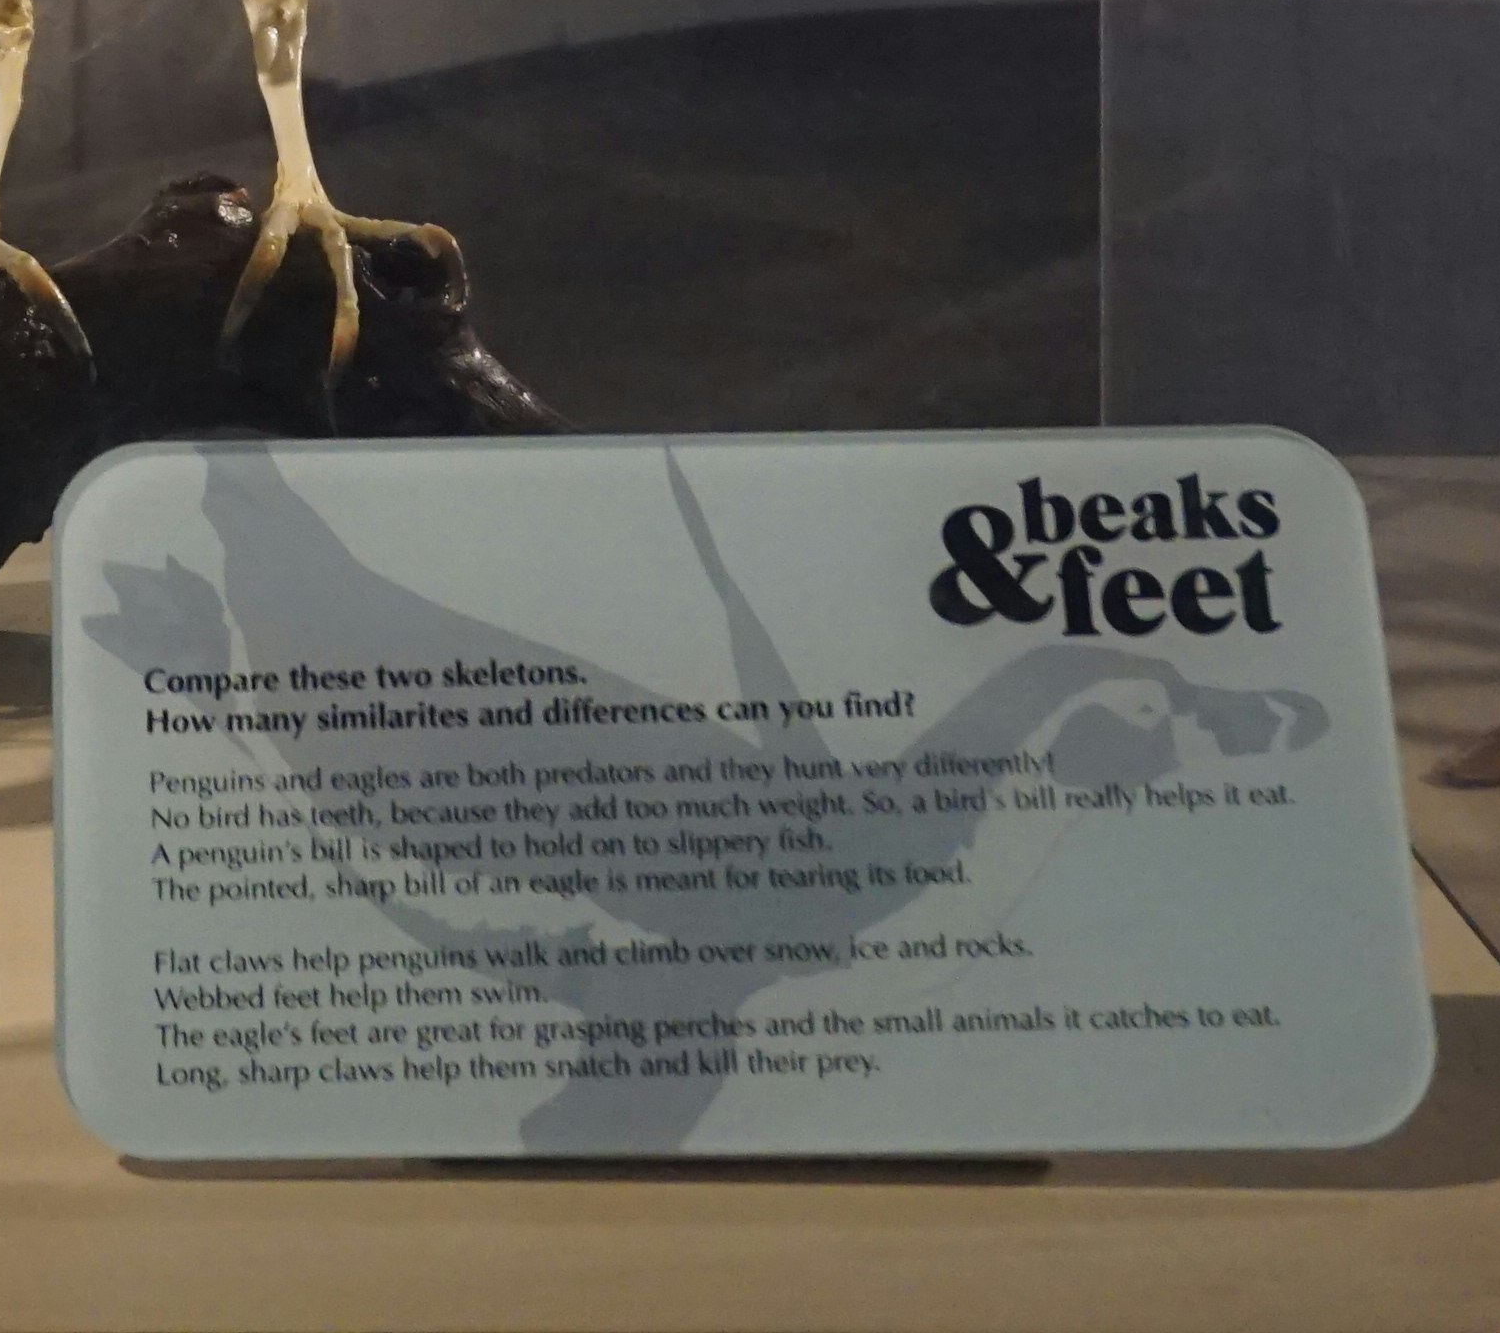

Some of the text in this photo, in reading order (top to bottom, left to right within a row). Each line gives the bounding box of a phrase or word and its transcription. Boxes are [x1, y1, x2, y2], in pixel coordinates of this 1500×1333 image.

[1018, 472, 1281, 545] beaks
[929, 504, 1283, 638] & feet
[144, 660, 587, 702] Compare these two skeletons.
[146, 690, 916, 739] How many similarites and differences can you find?
[150, 768, 265, 798] Penguins
[275, 766, 322, 792] and
[331, 766, 411, 796] eagles
[420, 767, 459, 788] are
[468, 761, 525, 787] both
[535, 758, 655, 793] predators
[663, 757, 712, 783] and
[720, 756, 774, 785] they
[783, 754, 842, 781] hunt
[851, 758, 903, 782] very
[150, 806, 190, 829] No
[199, 802, 250, 829] bird
[259, 799, 302, 827] has
[310, 800, 382, 829] teeth,
[391, 798, 496, 826] because
[504, 797, 560, 827] they
[568, 794, 617, 822] add
[624, 796, 668, 820] too
[675, 793, 749, 819] much
[758, 791, 852, 823] weight.
[912, 793, 927, 813] a
[1013, 786, 1056, 812] bill
[1065, 783, 1136, 815] really
[1145, 783, 1214, 814] helps
[1224, 782, 1241, 807] it
[1249, 785, 1296, 807] eat.
[151, 827, 832, 870] A penguin's bill is shaped to hold on to slippery fish.
[153, 859, 971, 907] The pointed, sharp bill of an eagle is meant for tearing its food.
[153, 932, 1033, 977] Flat claws help penguins walk and climb over snow, ice and rocks.
[154, 980, 548, 1013] Webbed feet help them swim.
[156, 1002, 1280, 1054] The eagle's feet are great for grasping perches and the small animals it catches to eat.
[156, 1047, 881, 1093] Long, sharp claws help them snatch and kill their prey.
